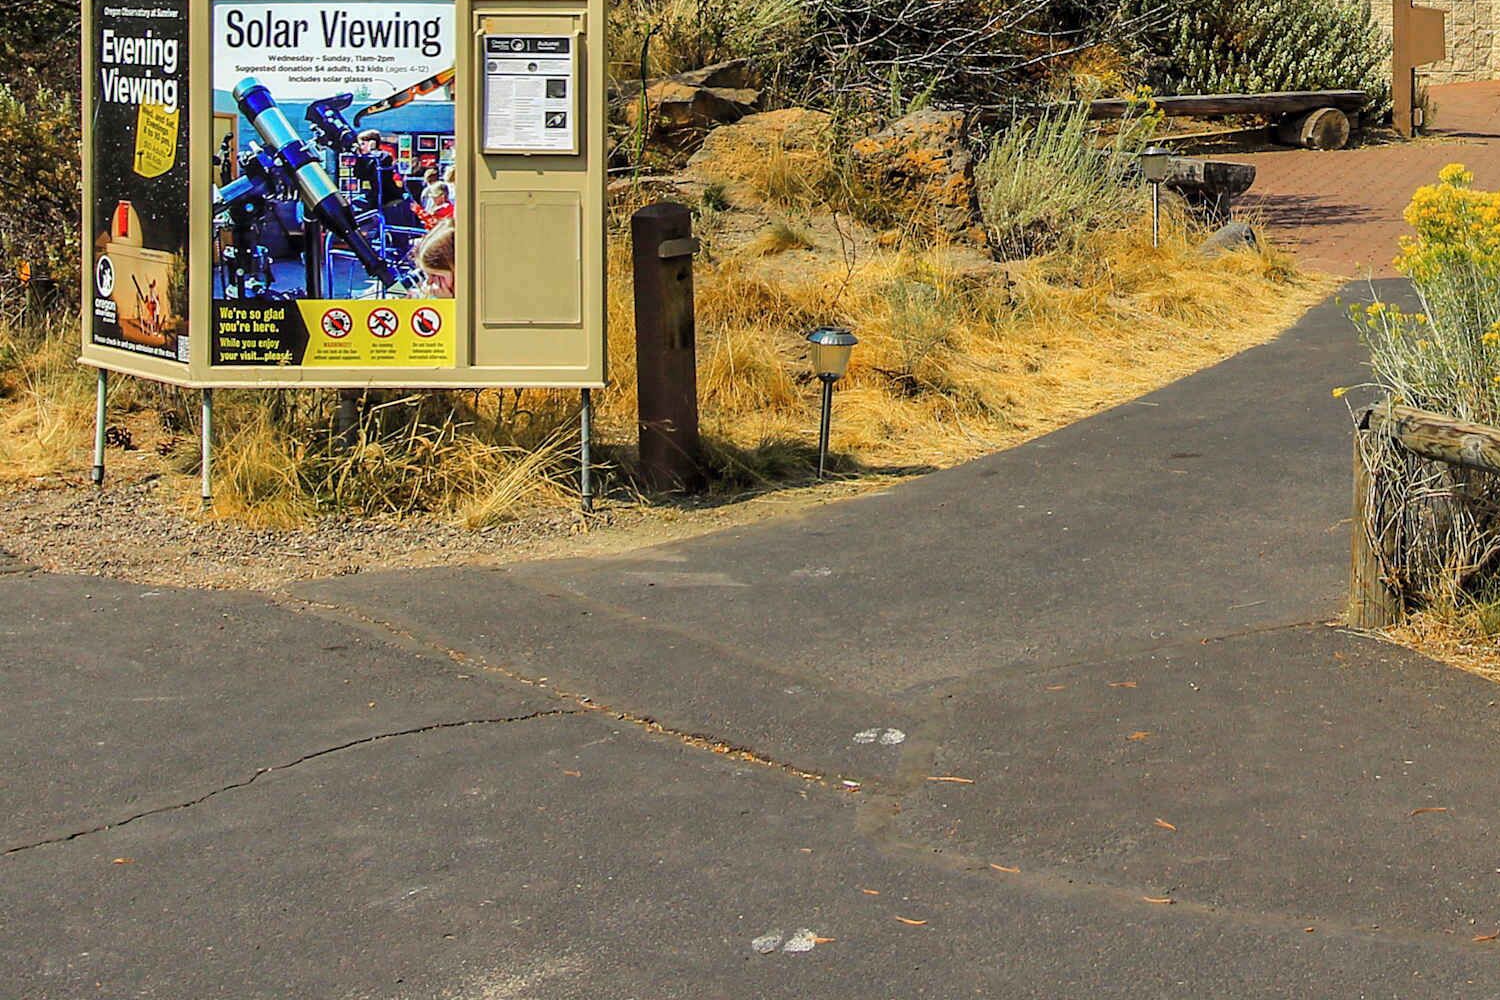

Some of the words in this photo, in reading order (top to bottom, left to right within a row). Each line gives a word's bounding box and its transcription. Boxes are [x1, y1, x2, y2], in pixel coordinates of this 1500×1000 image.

[226, 9, 309, 48] Solar
[320, 9, 442, 57] Viewing
[102, 29, 178, 74] Evening
[268, 55, 313, 63] Wednesday
[322, 55, 354, 63] Sunday,
[355, 55, 395, 63] 11am-2pm
[235, 65, 276, 73] Suggested
[327, 65, 353, 73] adults,
[385, 65, 407, 73] (ages
[410, 65, 429, 73] 4-12)
[101, 67, 178, 114] Viewing
[219, 307, 247, 319] We're
[249, 310, 261, 319] so
[263, 307, 285, 322] glad
[219, 320, 250, 334] you're
[253, 320, 280, 332] here.
[219, 337, 240, 347] While
[241, 339, 257, 349] you
[258, 338, 280, 349] enjoy
[219, 351, 238, 361] your
